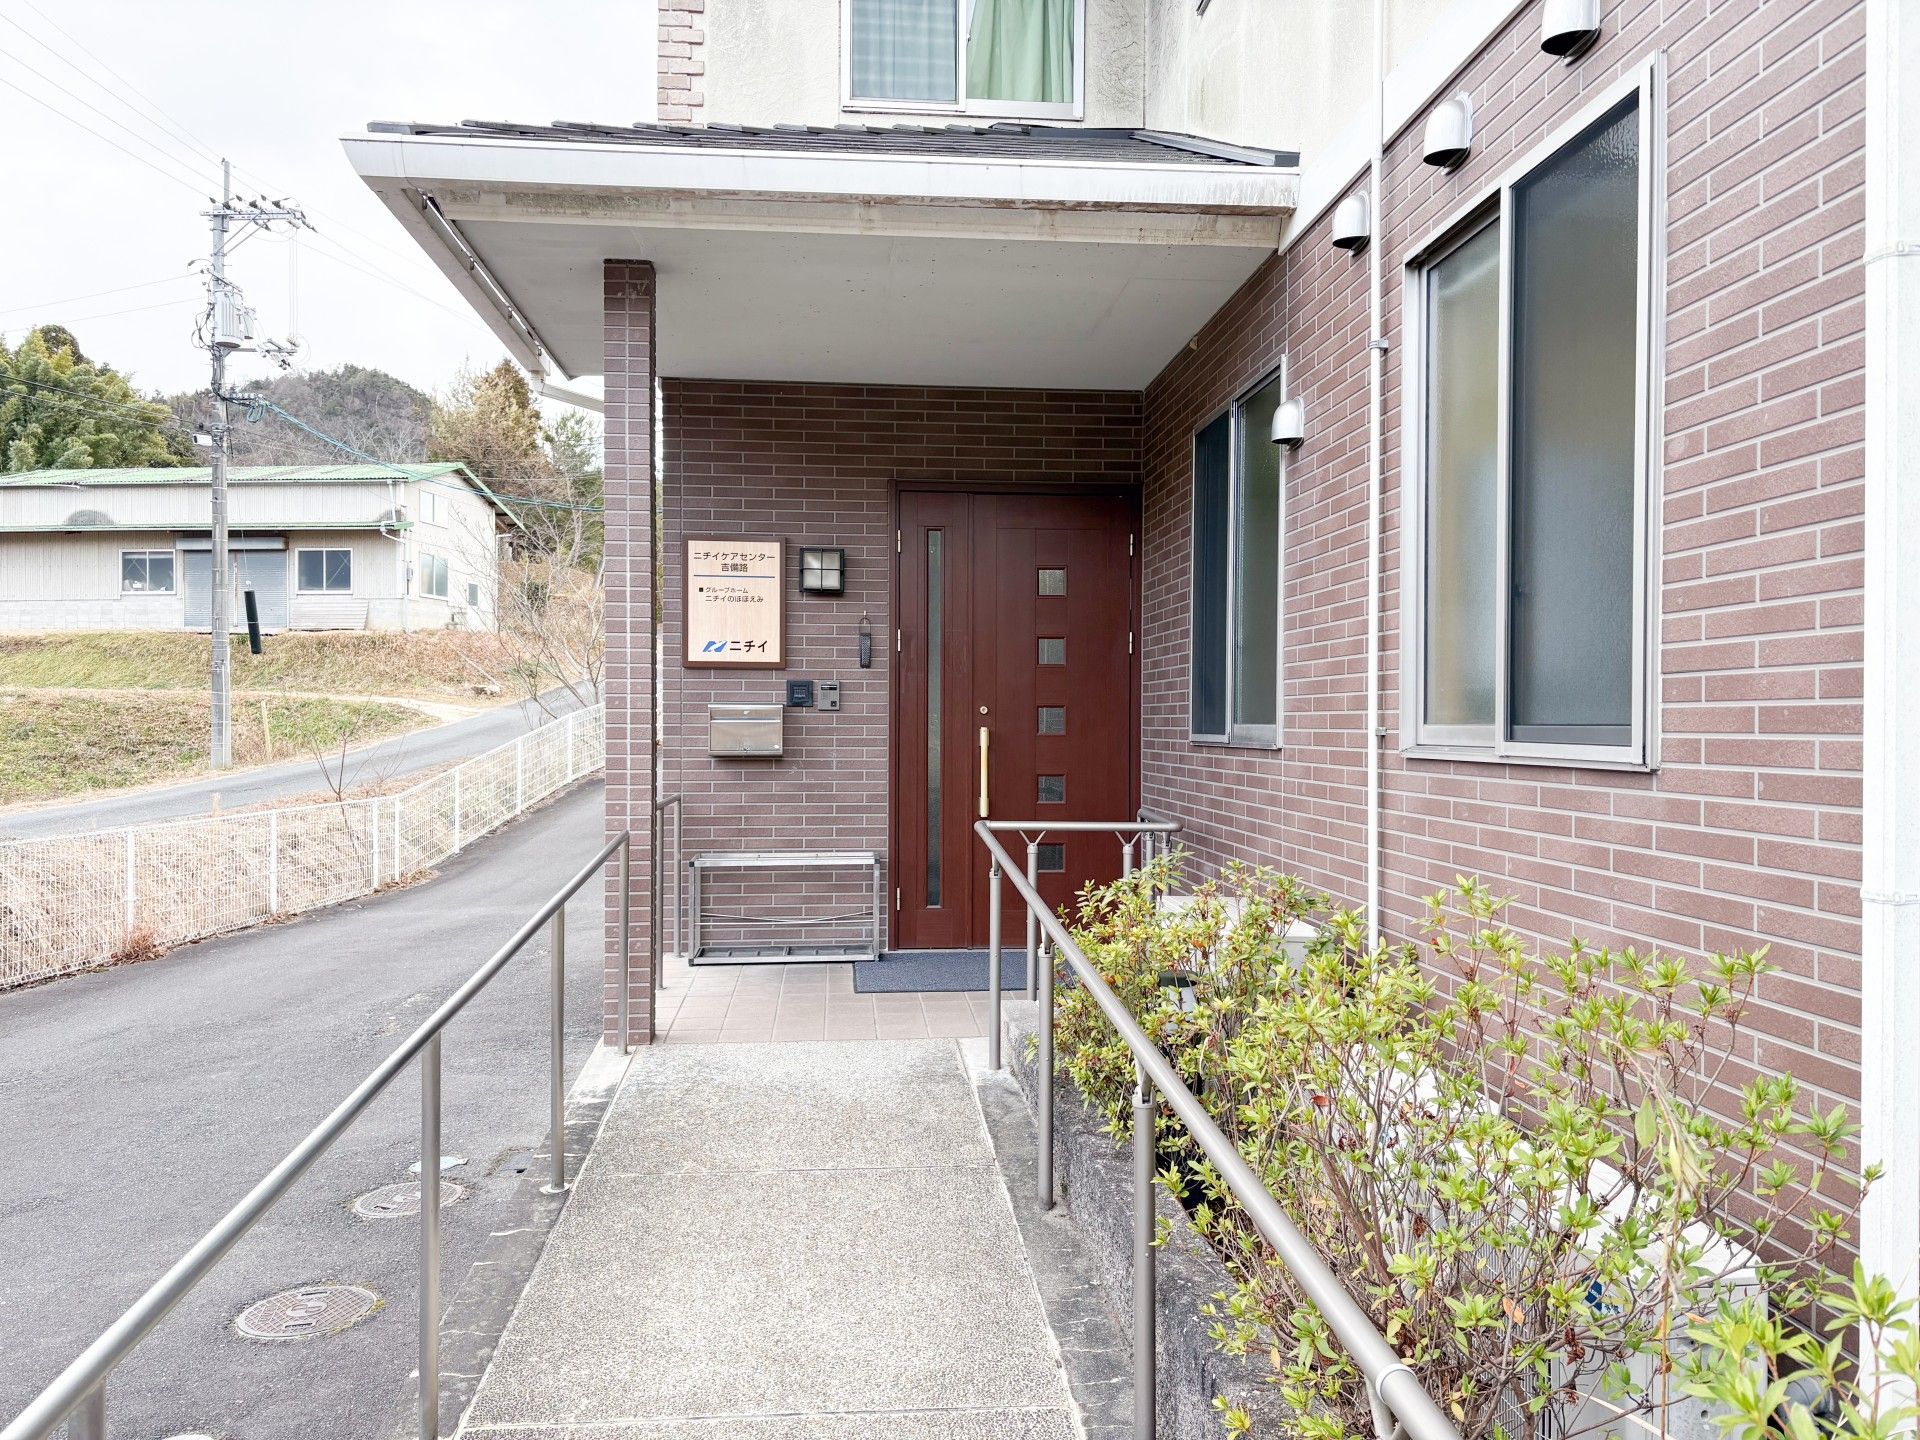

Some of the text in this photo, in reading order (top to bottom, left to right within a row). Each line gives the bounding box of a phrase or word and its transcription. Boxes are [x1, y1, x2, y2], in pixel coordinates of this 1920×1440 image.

[693, 551, 775, 561] ニチイケアセンター
[721, 563, 748, 572] 吉備路
[705, 595, 764, 603] ニチイのほほえみ
[729, 640, 768, 652] ニチイ
